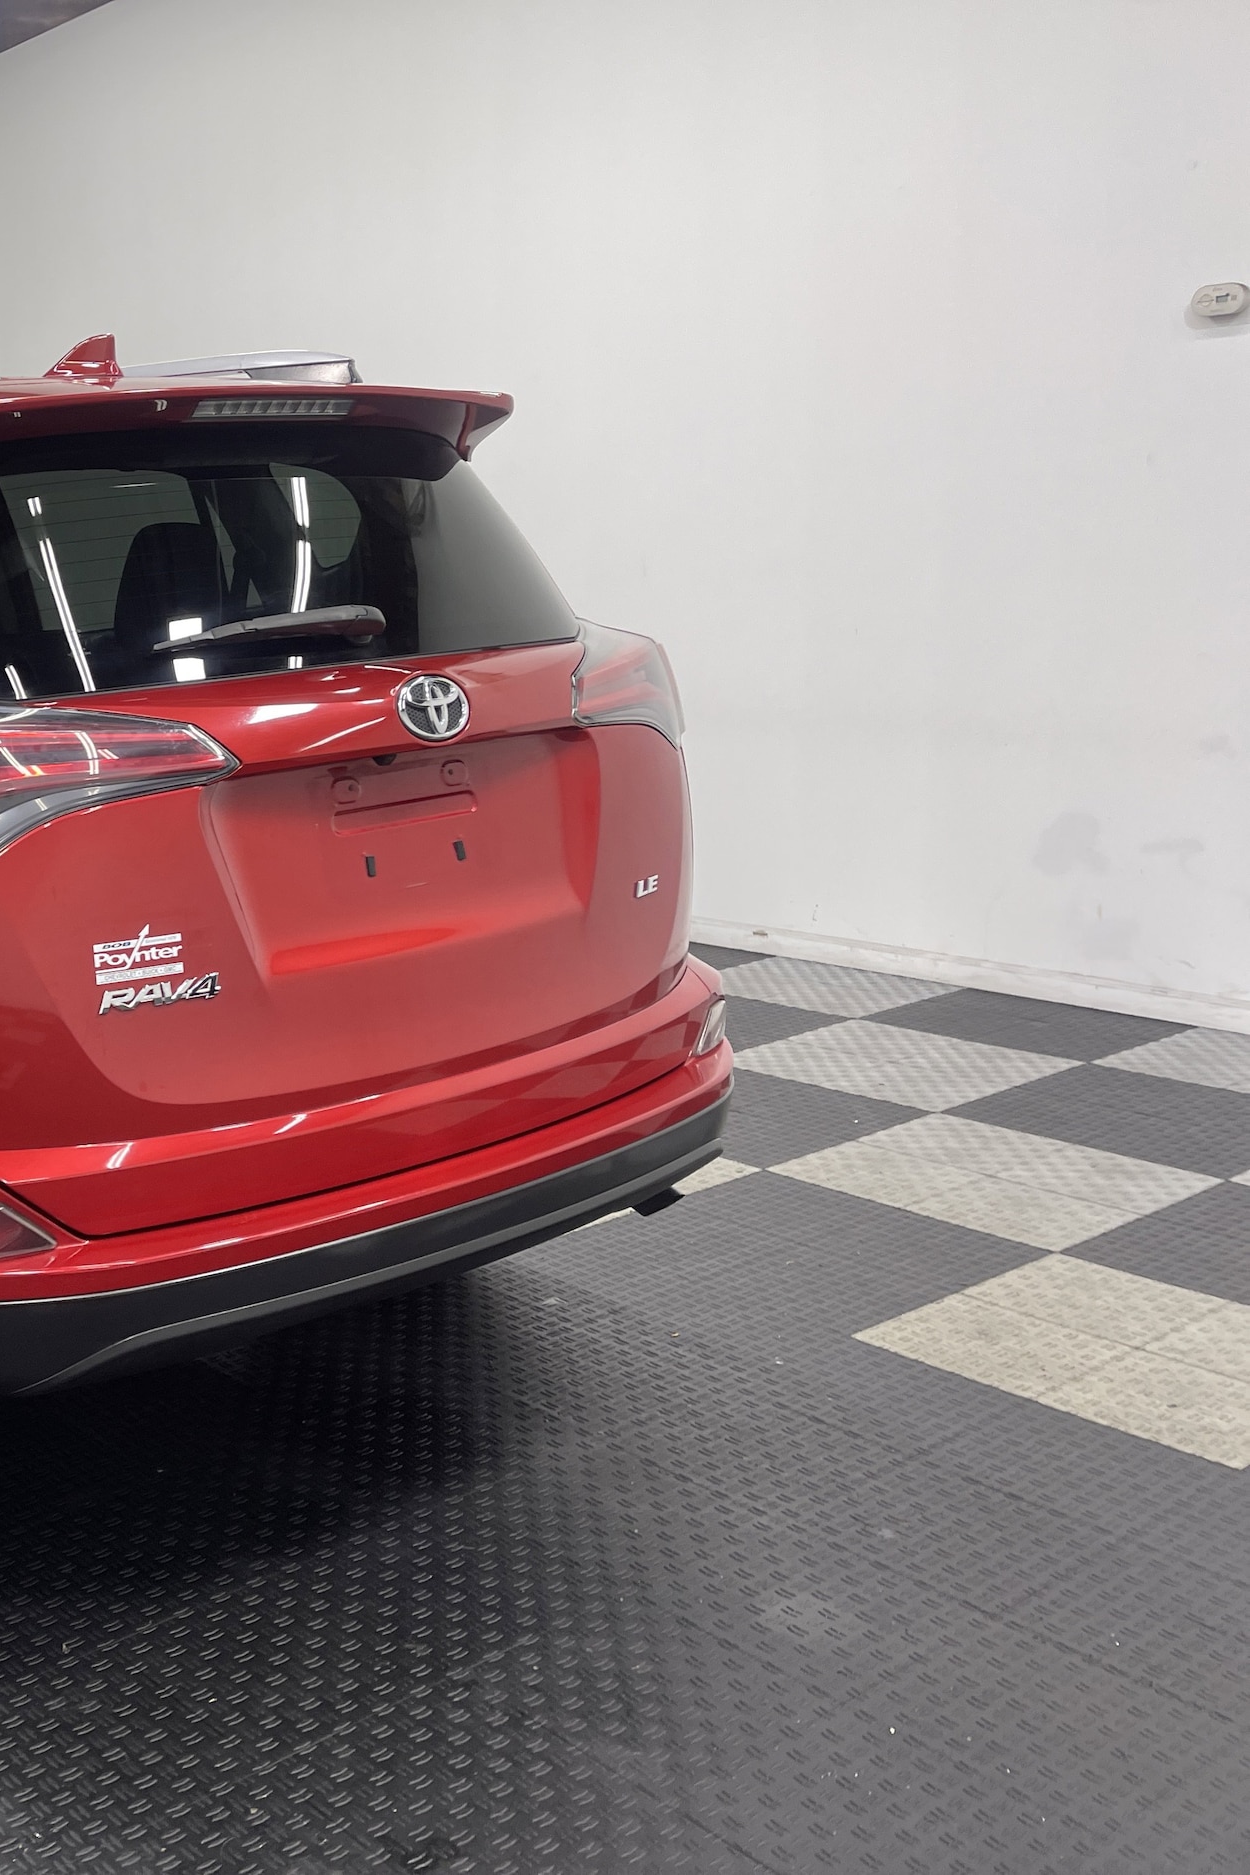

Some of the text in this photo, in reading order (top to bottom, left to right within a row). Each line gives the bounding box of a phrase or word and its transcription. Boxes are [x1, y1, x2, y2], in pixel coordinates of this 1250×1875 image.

[634, 874, 659, 899] LE
[94, 945, 183, 969] Poynter
[102, 941, 131, 950] BOB
[99, 972, 221, 1015] RAV4
